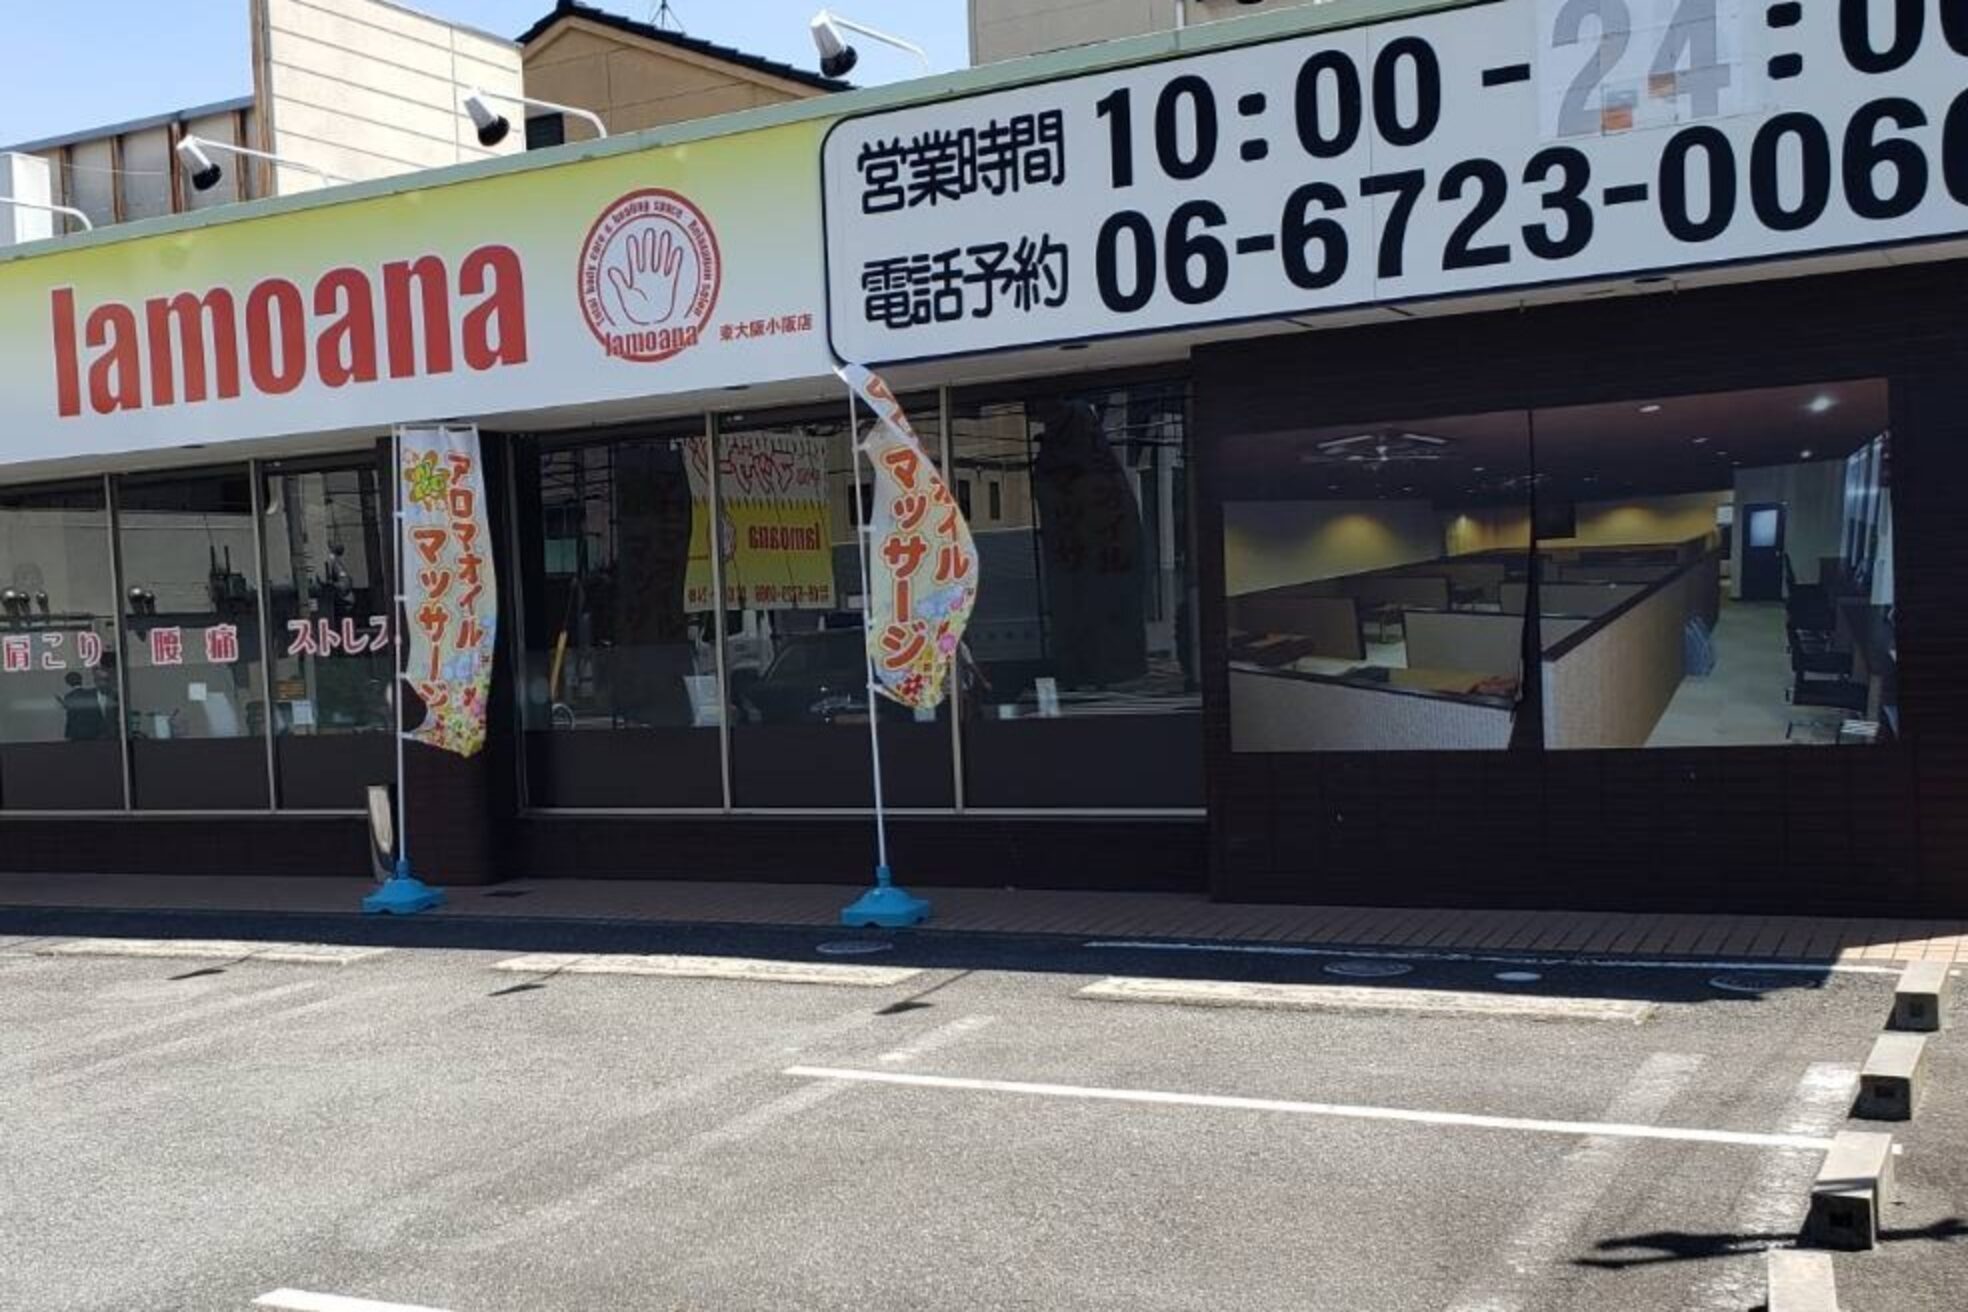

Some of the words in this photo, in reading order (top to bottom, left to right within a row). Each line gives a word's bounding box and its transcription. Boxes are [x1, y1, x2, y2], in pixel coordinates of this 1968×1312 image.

[857, 109, 1065, 214] 営業時間
[1096, 35, 1442, 190] 10:00
[51, 244, 528, 417] lamoana
[606, 325, 698, 358] lamoana
[861, 233, 1069, 328] 電話予約
[413, 529, 451, 708] マッサージ
[448, 453, 485, 649] アロマオイル
[882, 449, 928, 668] マッサージ
[3, 632, 101, 672] 肩こり
